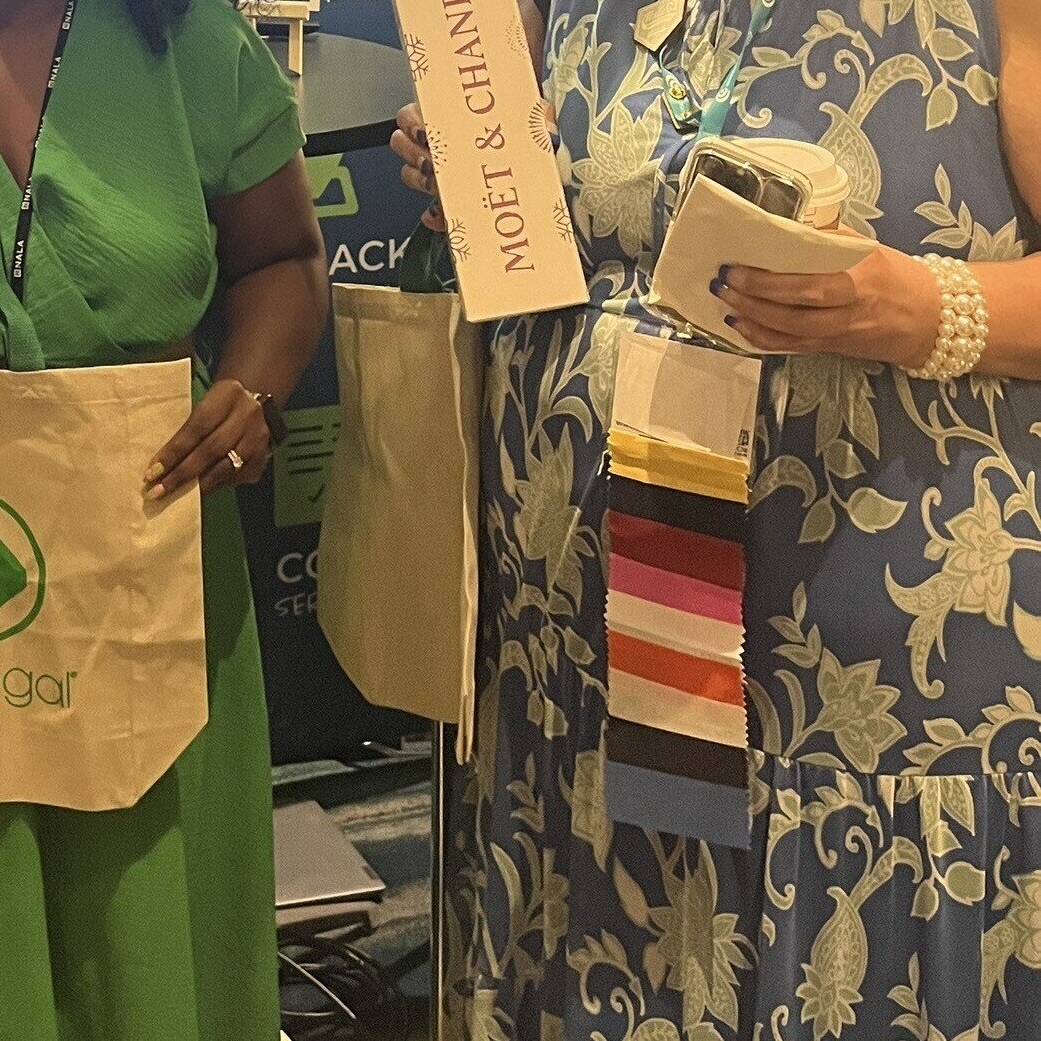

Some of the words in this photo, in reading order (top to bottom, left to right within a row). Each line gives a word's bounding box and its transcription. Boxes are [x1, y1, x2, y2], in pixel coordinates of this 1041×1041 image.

[474, 122, 505, 151] &
[482, 163, 536, 275] MOËT
[14, 240, 25, 269] NALA
